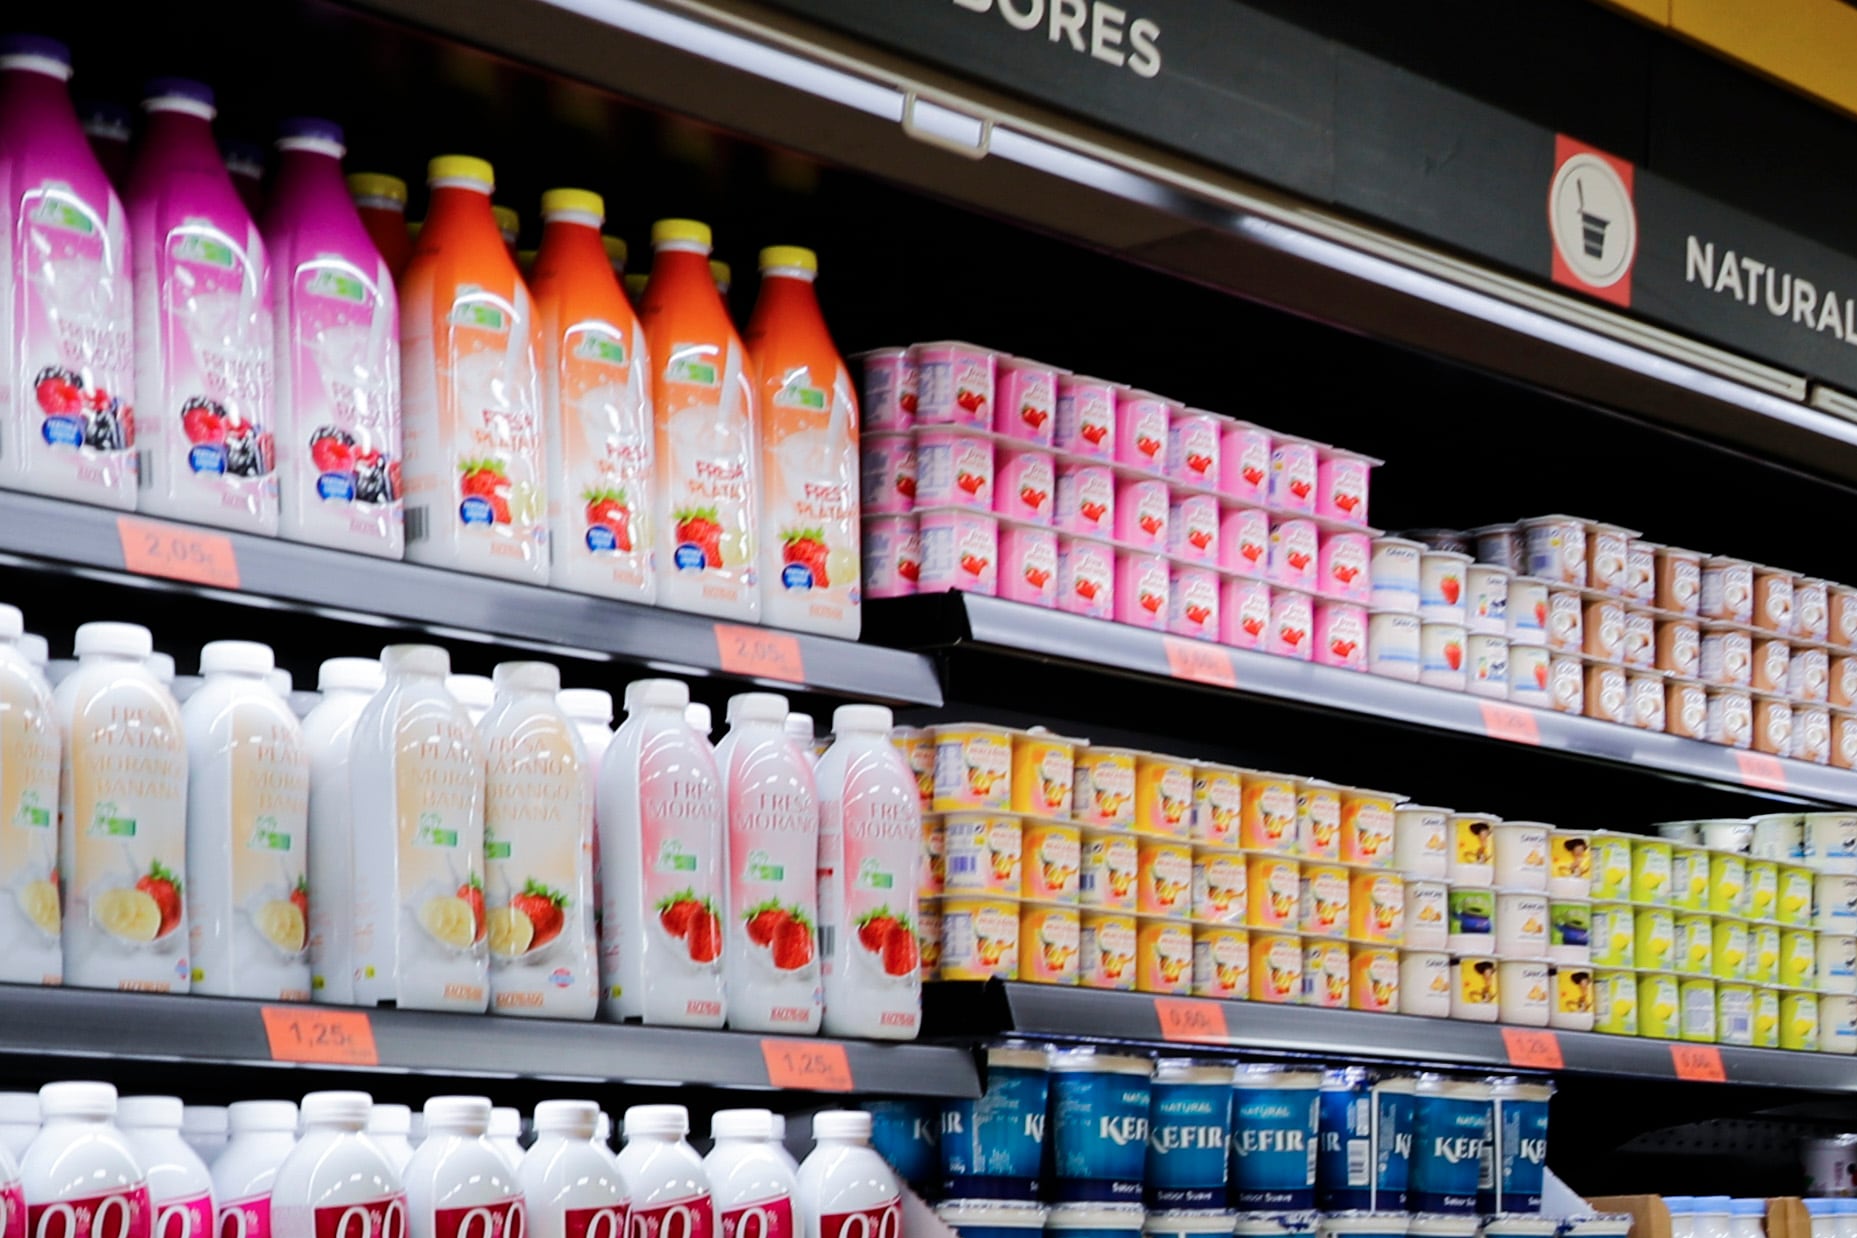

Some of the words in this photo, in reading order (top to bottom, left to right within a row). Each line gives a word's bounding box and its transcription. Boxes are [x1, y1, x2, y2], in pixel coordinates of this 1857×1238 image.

[953, 0, 1161, 78] ORES
[1099, 1115, 1149, 1146] KEF
[1149, 1125, 1225, 1155] KEFIR
[1230, 1130, 1305, 1157] KEFIR
[1434, 1136, 1481, 1164] KEF
